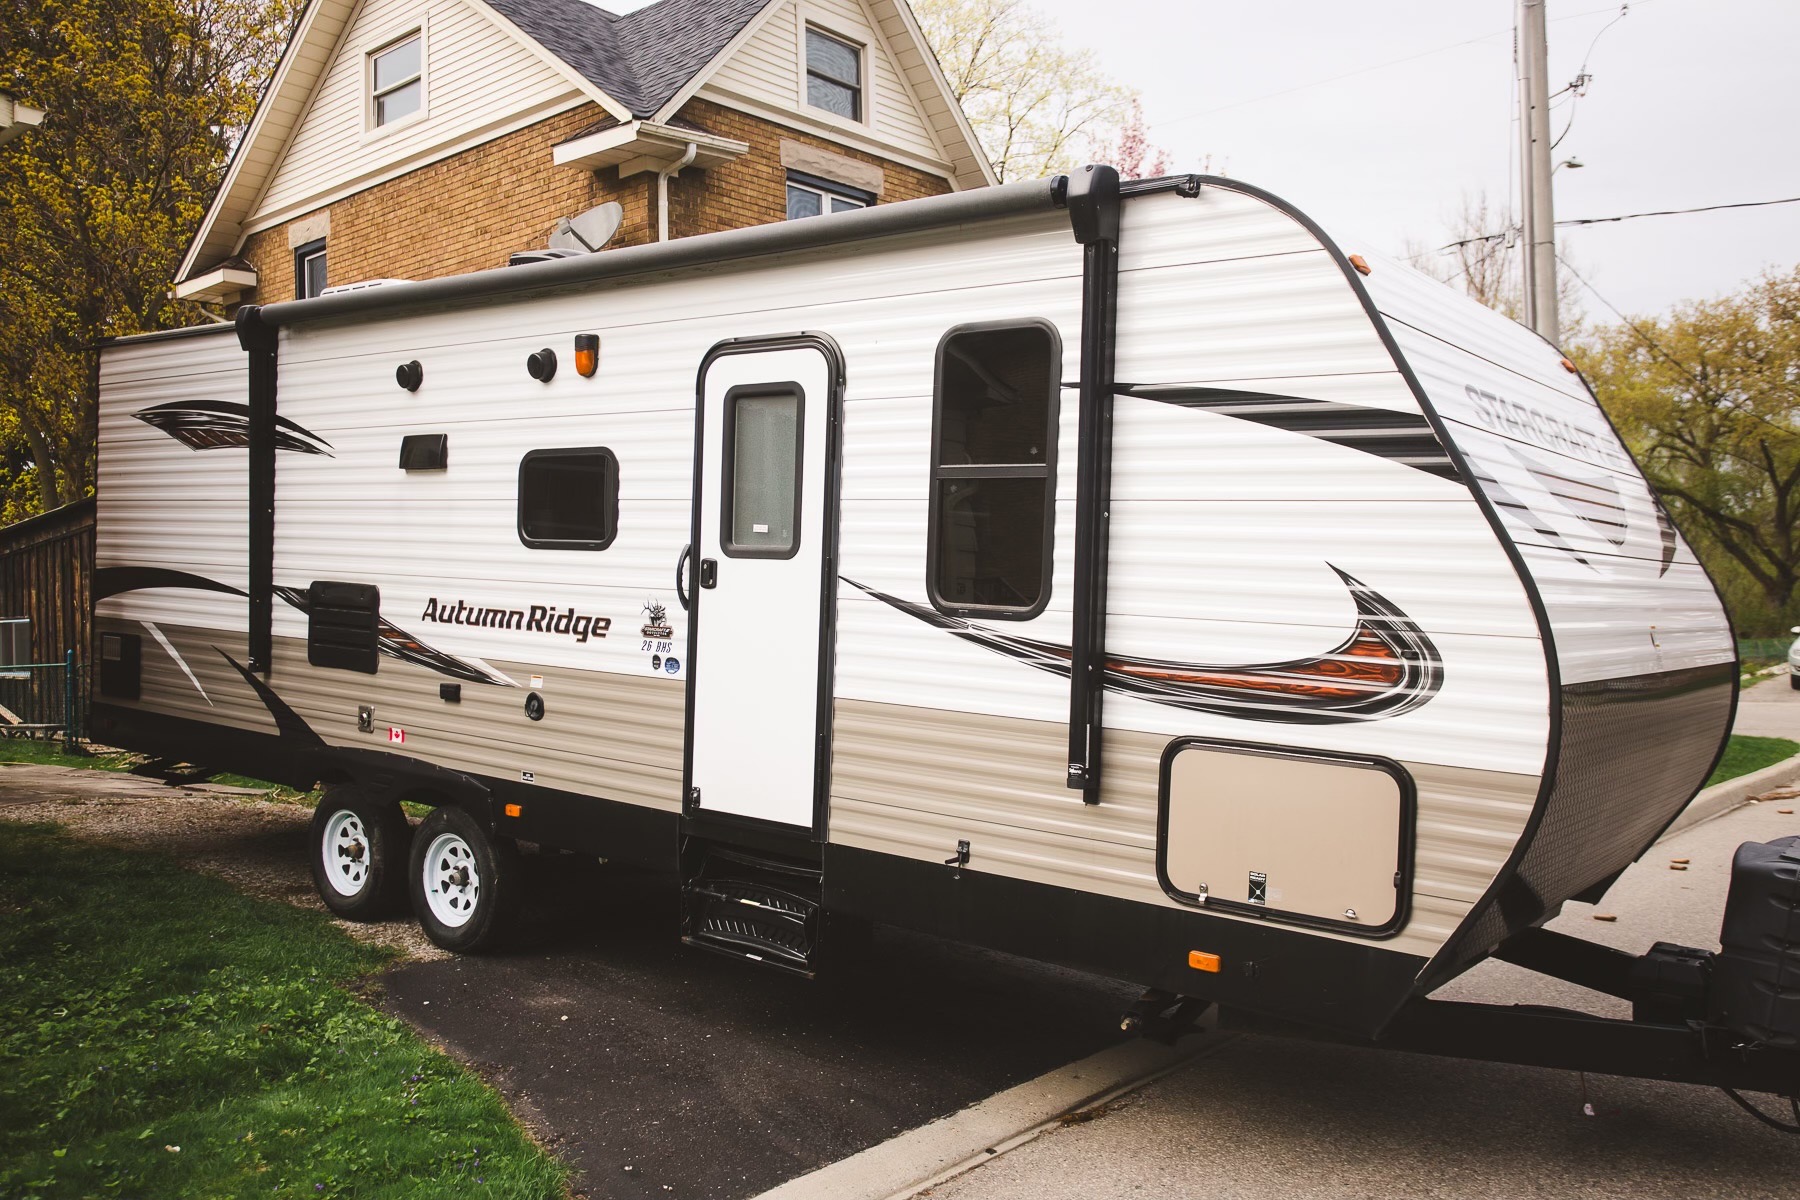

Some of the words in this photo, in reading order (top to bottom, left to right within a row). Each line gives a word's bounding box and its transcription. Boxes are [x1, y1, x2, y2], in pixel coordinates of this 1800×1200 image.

[421, 597, 525, 630] Autumn
[526, 605, 612, 643] Ridge
[641, 640, 652, 651] 26
[656, 641, 672, 653] BHS
